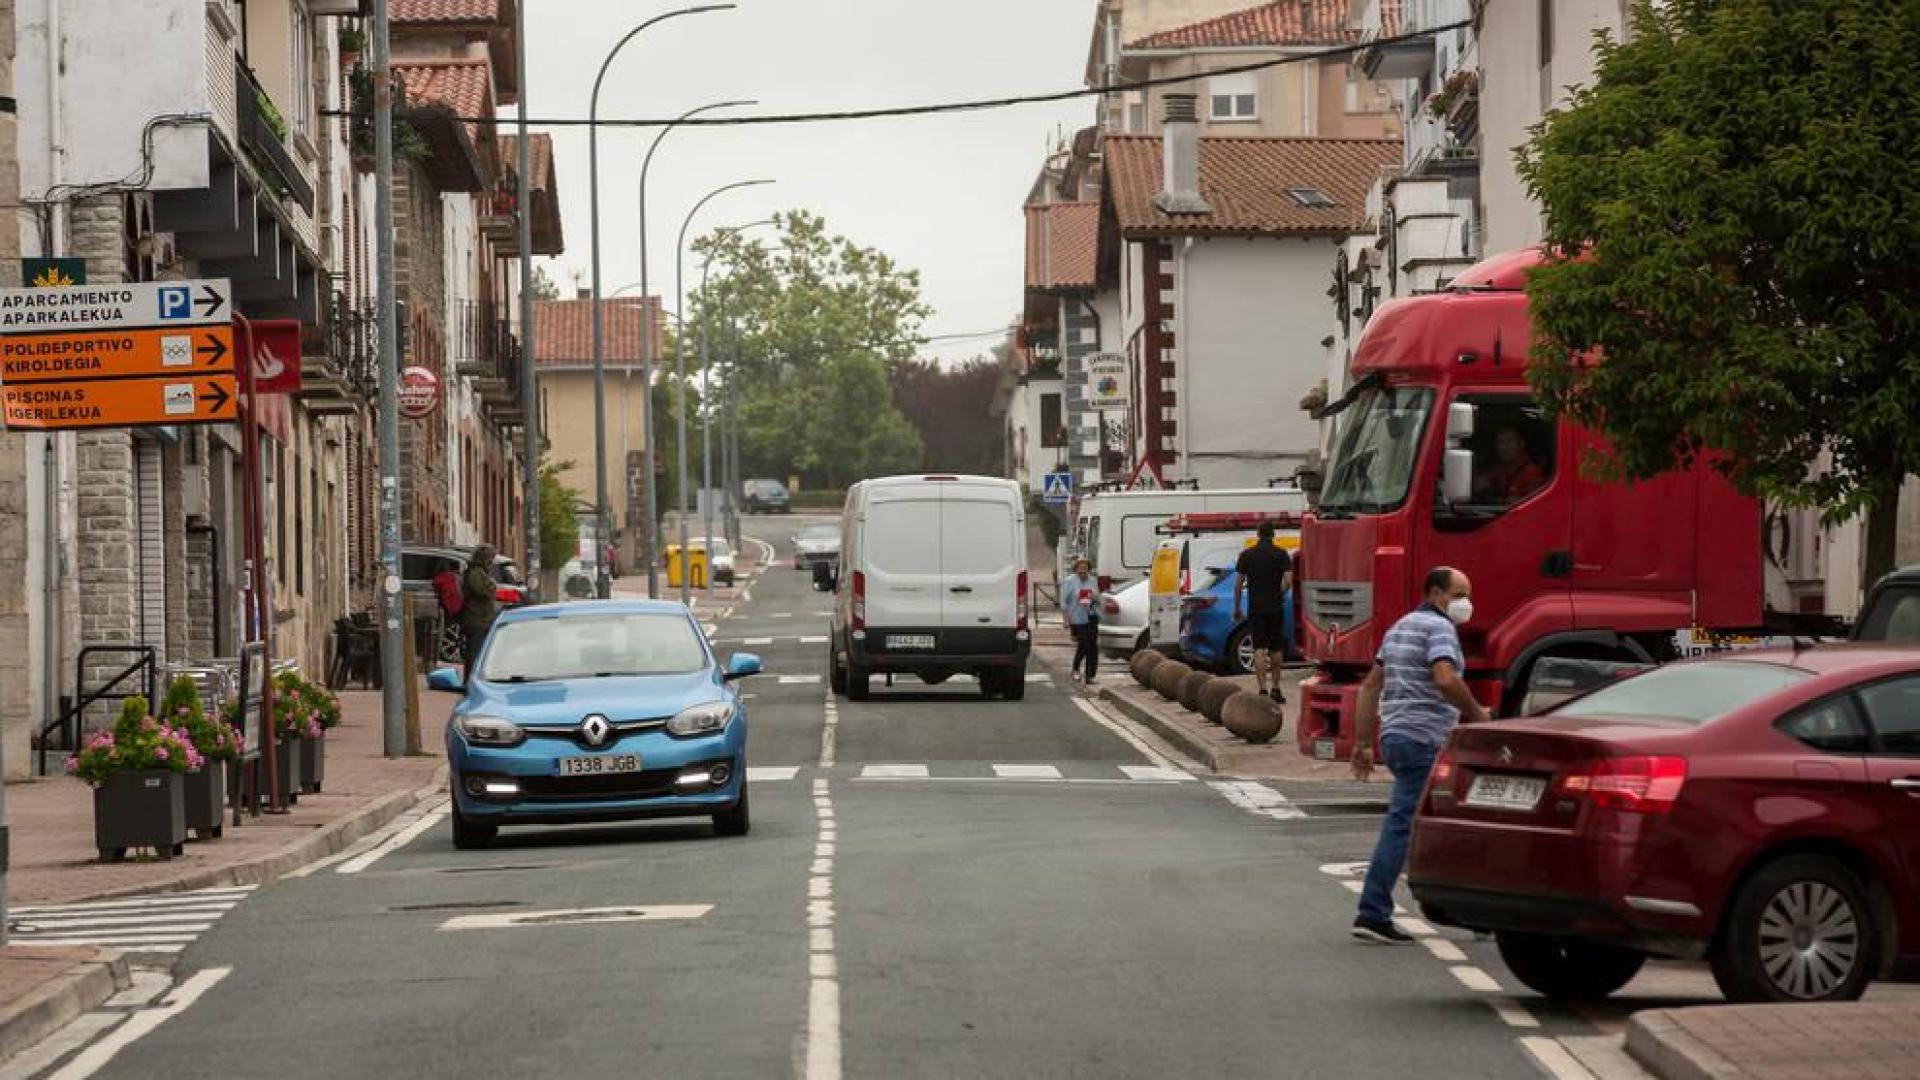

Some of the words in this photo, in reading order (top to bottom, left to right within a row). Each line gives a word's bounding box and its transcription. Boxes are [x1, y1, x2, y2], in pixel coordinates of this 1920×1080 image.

[2, 290, 133, 308] APARCAMIENTO
[163, 290, 184, 317] P
[3, 307, 123, 325] APARKALEKUA
[3, 338, 133, 356] POLIDEPORTIVO
[5, 357, 101, 373] KIROLDEGIA
[7, 389, 86, 403] PISCINAS
[9, 406, 102, 420] IGERILEKUA
[566, 757, 603, 774] 1338
